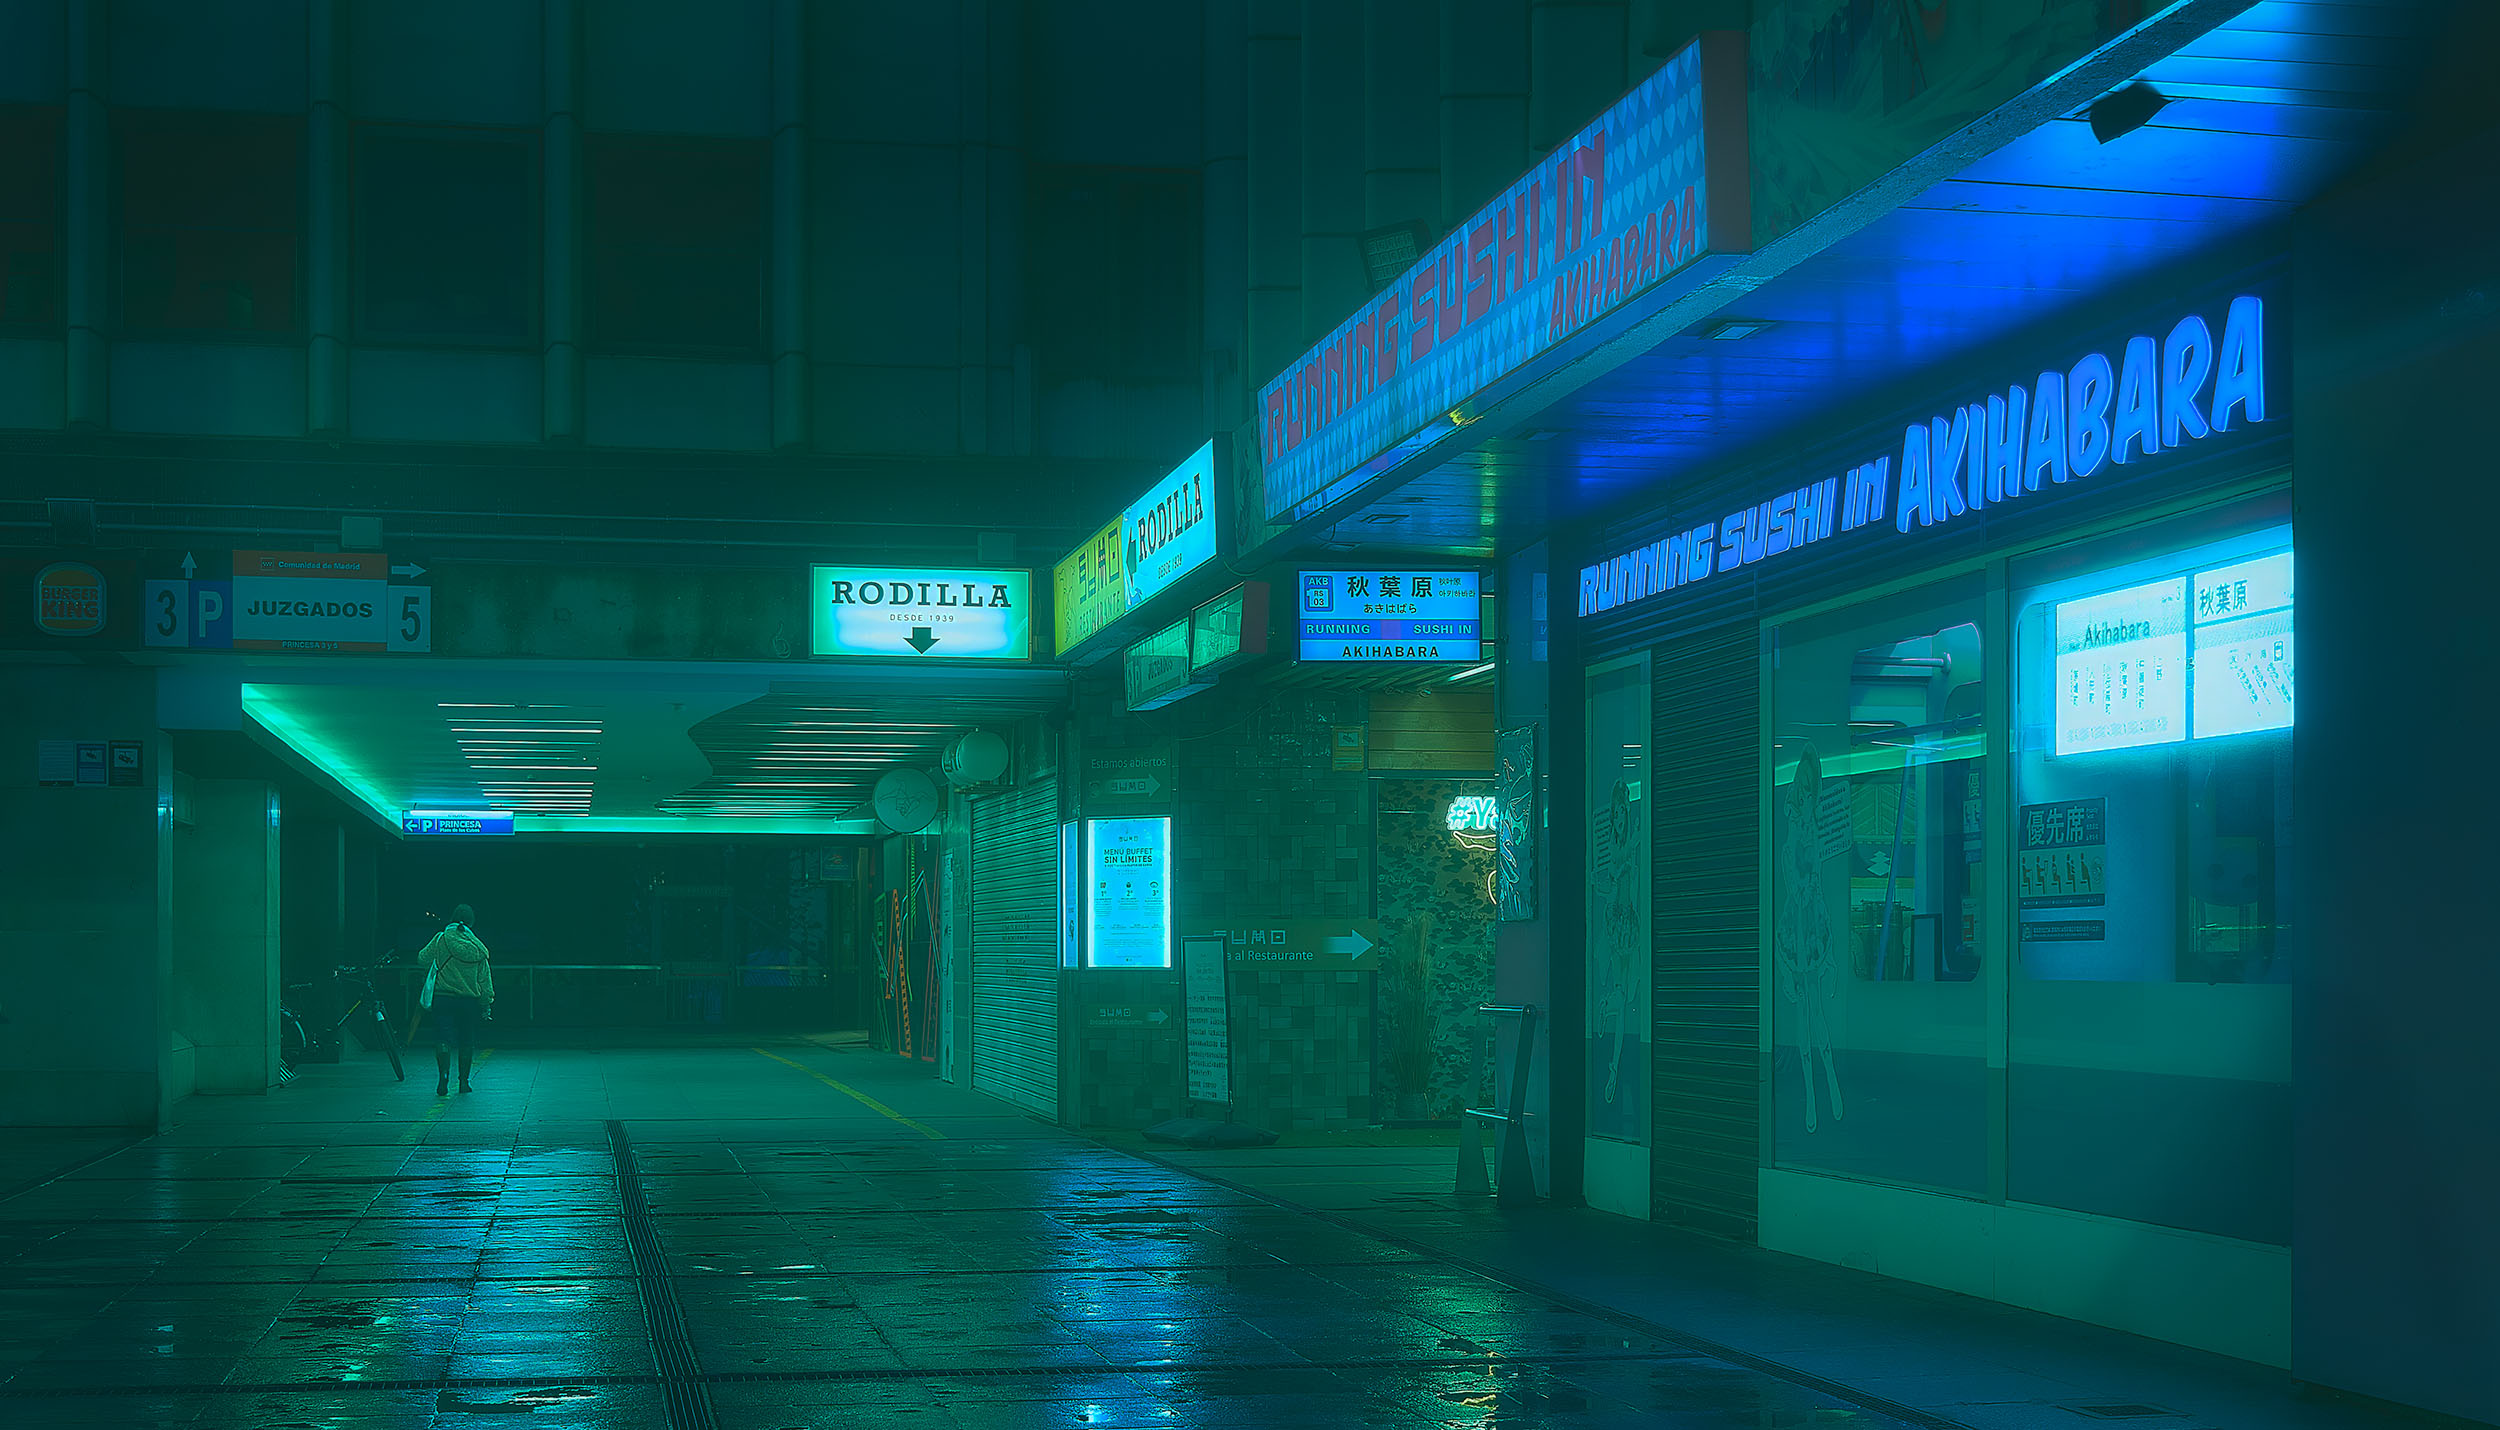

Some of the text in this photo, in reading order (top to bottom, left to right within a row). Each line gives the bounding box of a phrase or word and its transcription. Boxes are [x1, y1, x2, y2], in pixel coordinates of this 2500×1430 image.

[1548, 186, 1696, 342] AKIHABARA
[1267, 130, 1605, 465] RUNNING SUSHI IN
[1579, 296, 2264, 617] RUNNING SUSHI IN AKIHABARA
[1137, 472, 1204, 563] RODILLA
[278, 560, 361, 571] Comunidad de Madrid
[1308, 577, 1329, 586] AKB
[1347, 575, 1434, 599] 秋葉原
[41, 586, 99, 602] BURGER
[831, 580, 1012, 608] RODILLA
[1314, 598, 1325, 606] 03
[2198, 579, 2249, 618] 秋葉原
[41, 600, 99, 619] KING
[157, 590, 177, 637] 3
[199, 590, 225, 640] P
[247, 600, 374, 618] JUZGADOS
[1363, 603, 1417, 615] あきはばら
[400, 595, 422, 642] 5
[890, 613, 955, 623] DESDE 1939
[1306, 624, 1473, 635] RUNNING SUSHI IN
[2084, 619, 2151, 648] Akihabara
[1342, 646, 1440, 658] AKIHABARA
[1091, 756, 1167, 769] Estamos abiertos
[423, 819, 433, 832] P
[439, 820, 482, 828] PRINCESA
[2027, 804, 2085, 847] 優先席
[1104, 847, 1153, 855] MENÚ BUFFET
[1104, 854, 1153, 864] SIN LÍMITES
[1247, 950, 1314, 962] Restaurante
